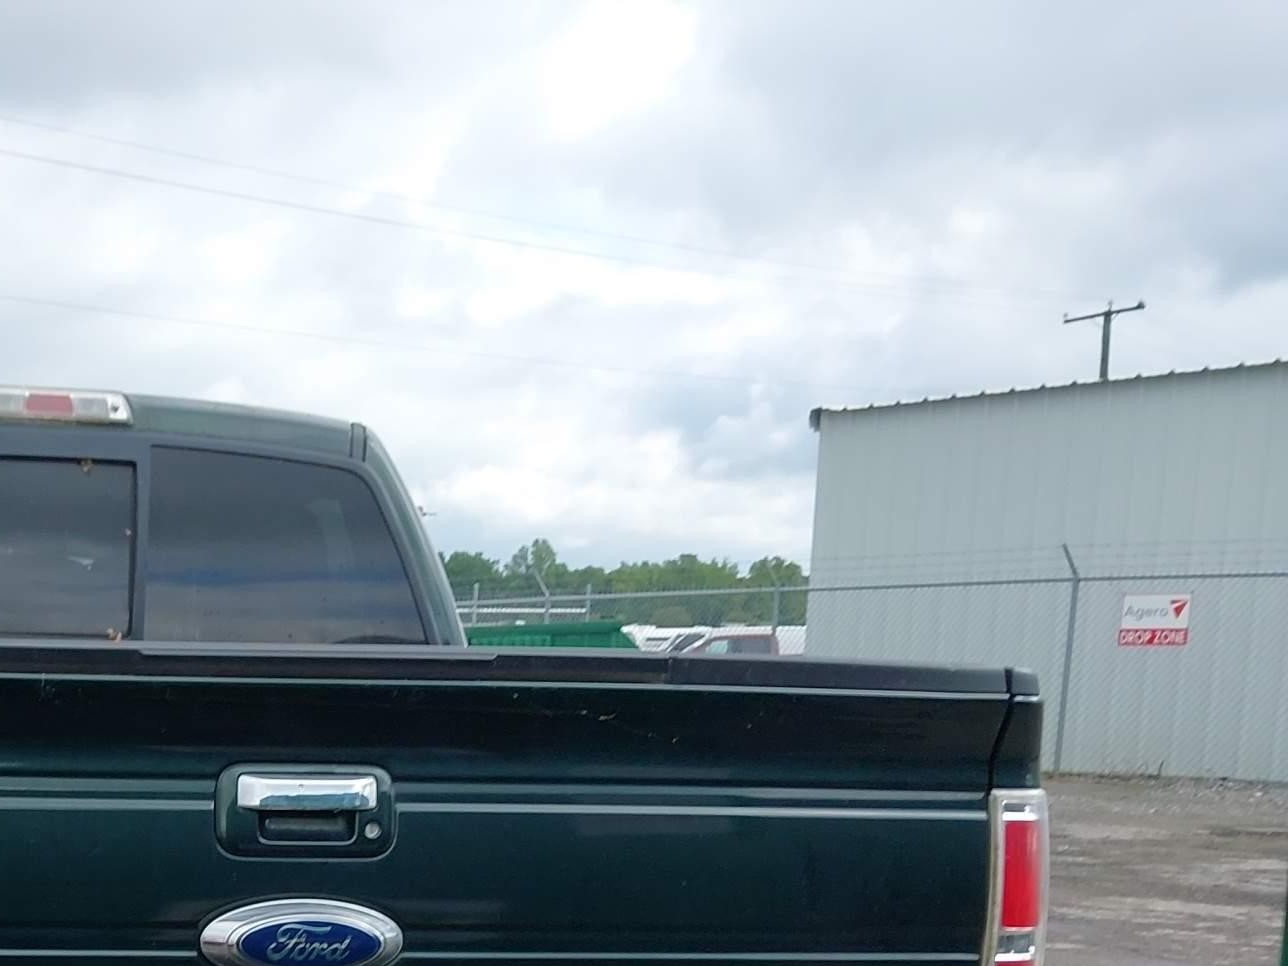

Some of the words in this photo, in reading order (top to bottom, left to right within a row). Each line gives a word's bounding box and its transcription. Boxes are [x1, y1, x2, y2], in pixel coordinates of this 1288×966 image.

[1123, 604, 1169, 622] Agero
[1119, 629, 1151, 645] DROP
[1153, 629, 1187, 645] ZONE
[267, 923, 352, 961] Ford
